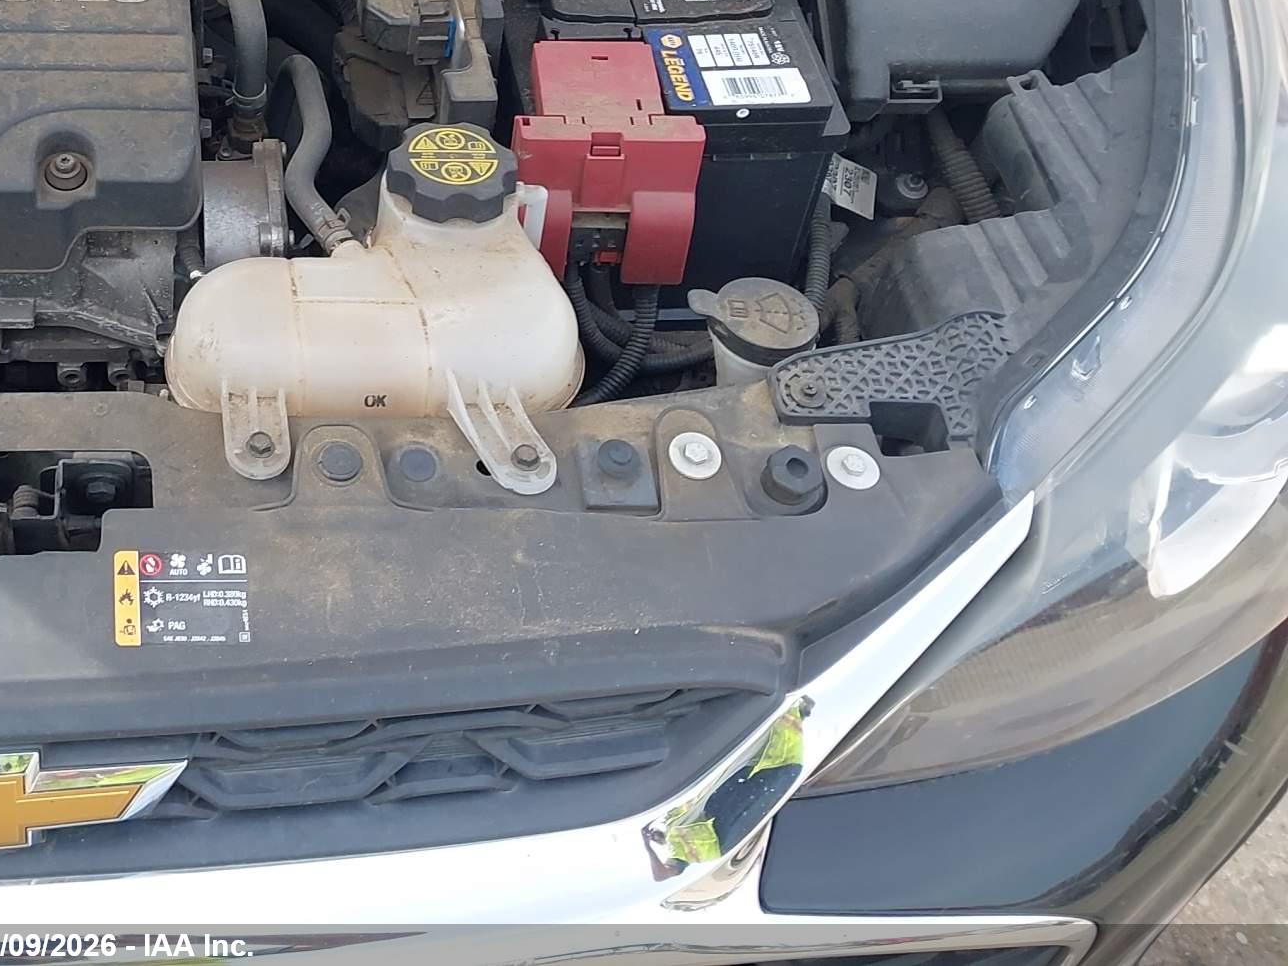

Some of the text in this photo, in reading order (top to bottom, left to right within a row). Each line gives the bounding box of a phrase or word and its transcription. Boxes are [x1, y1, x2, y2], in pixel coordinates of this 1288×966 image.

[364, 394, 388, 408] OK
[169, 568, 188, 576] AUTO
[167, 621, 186, 630] PAG
